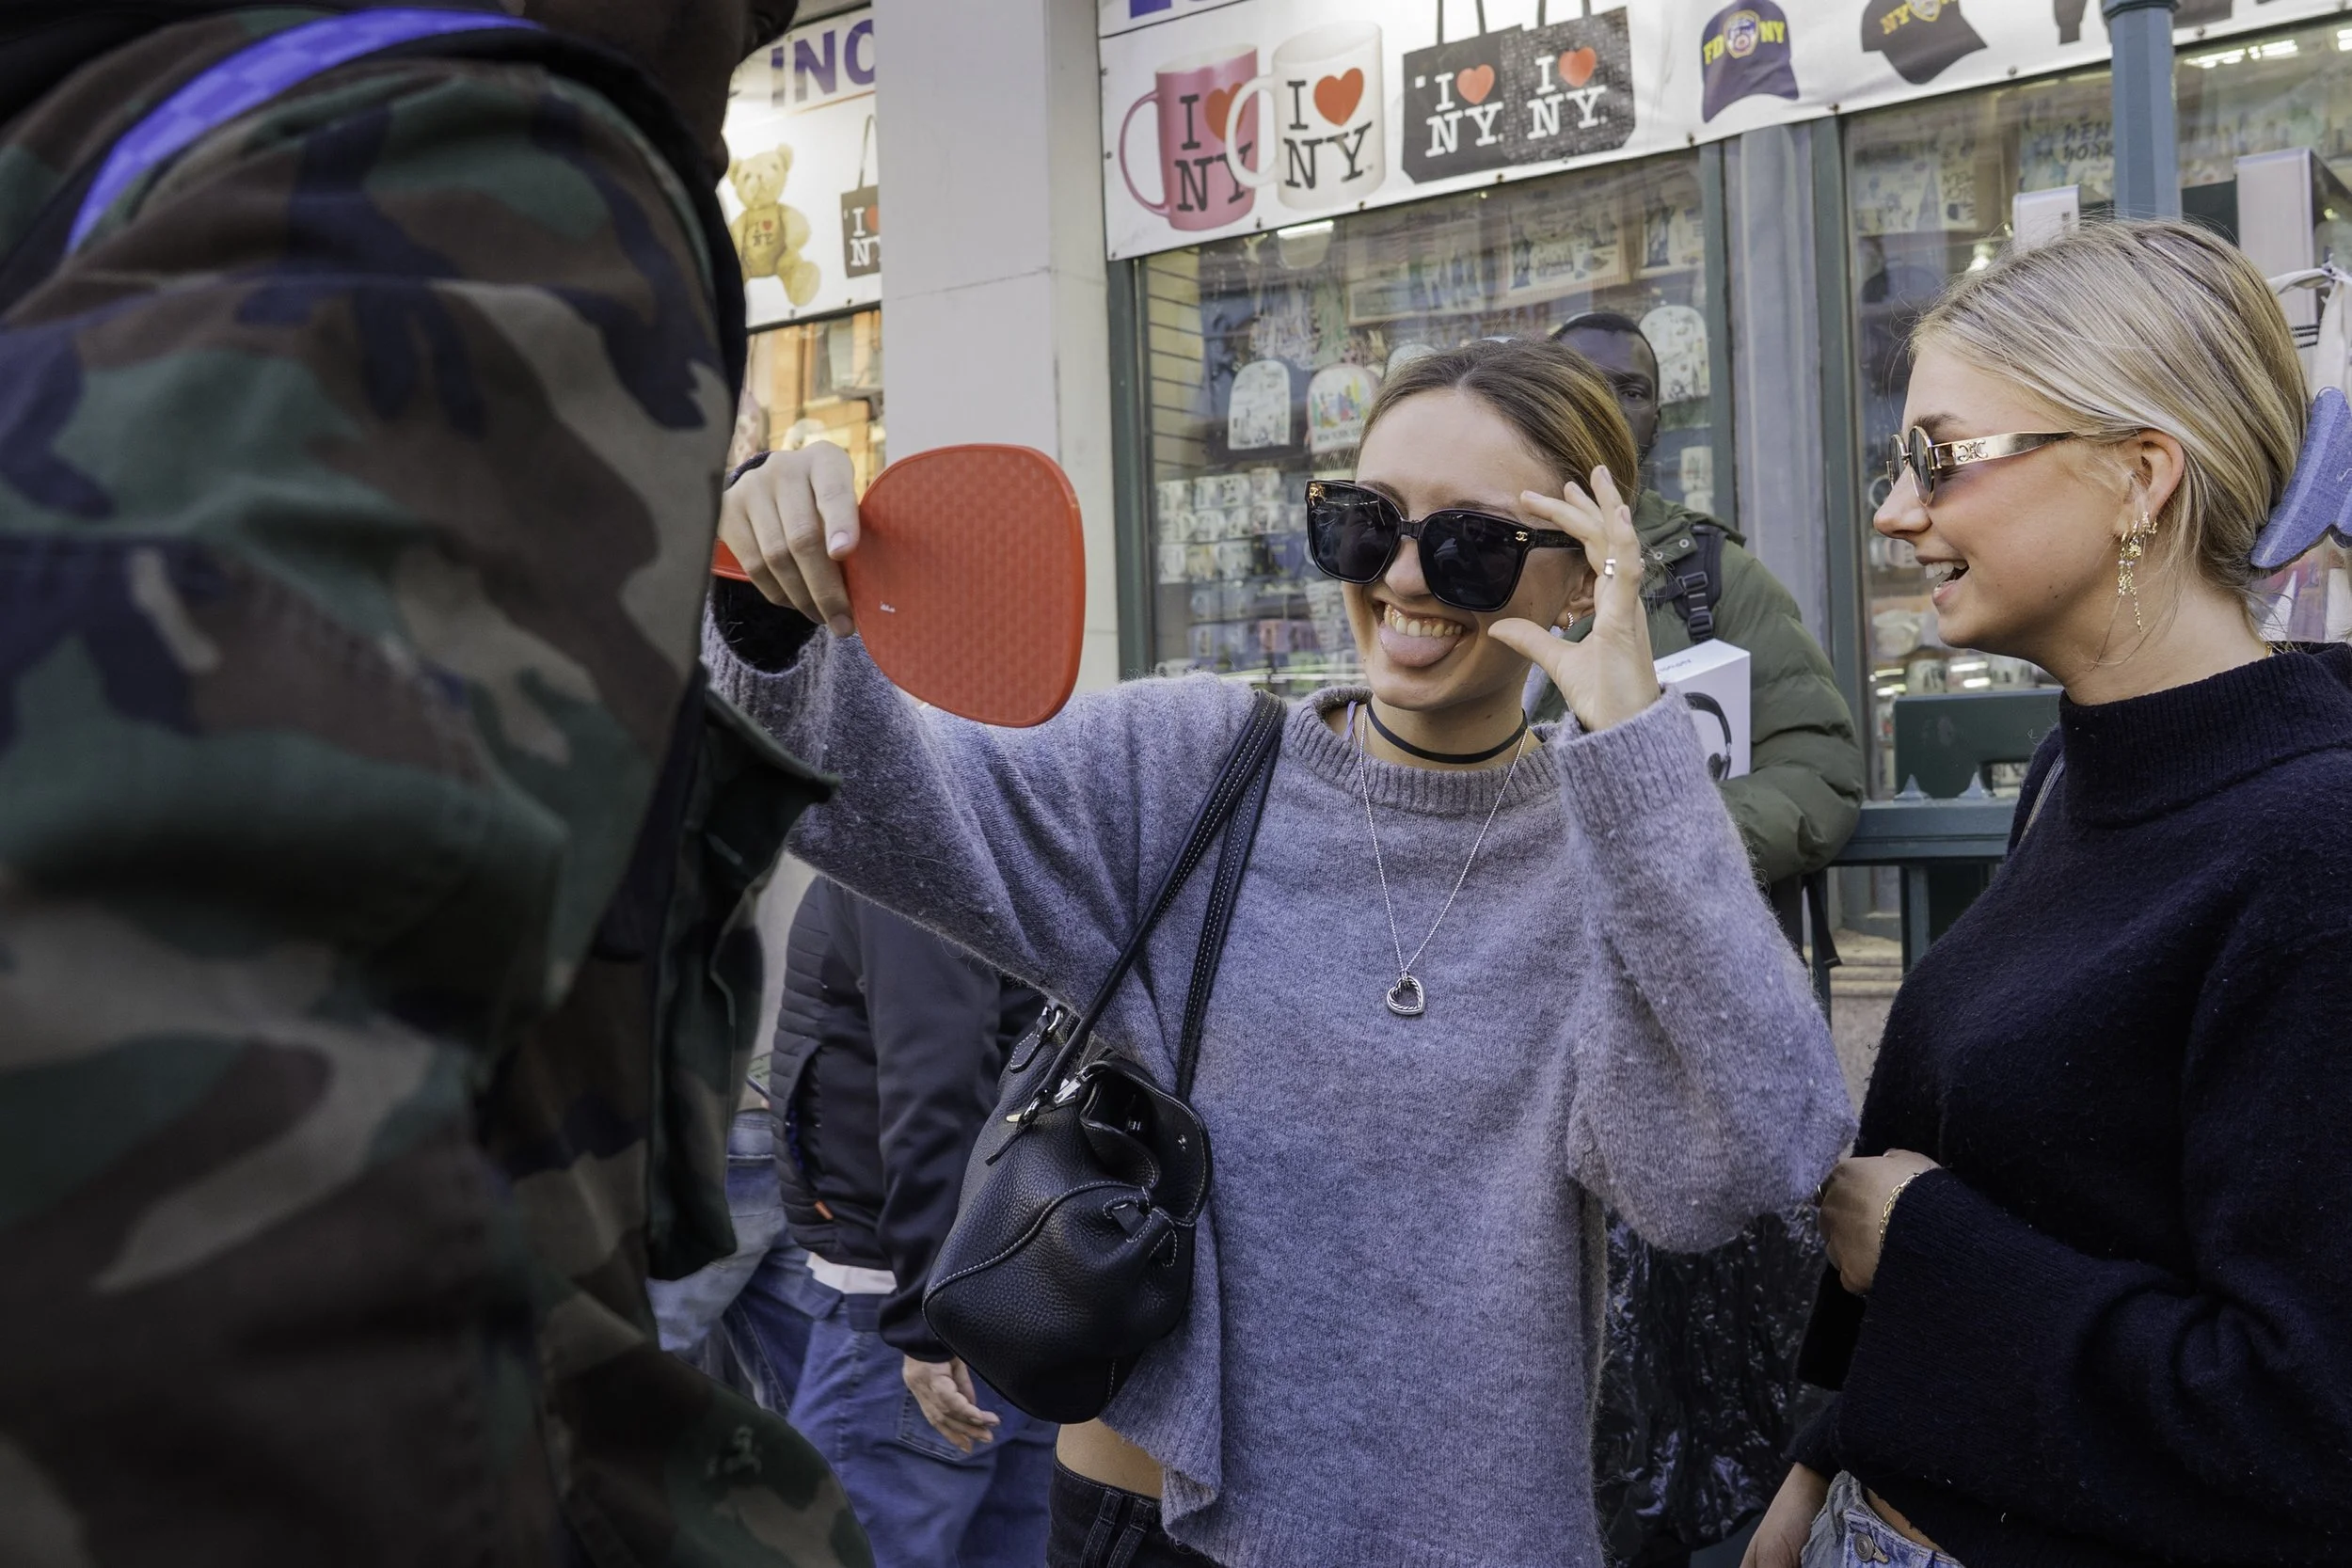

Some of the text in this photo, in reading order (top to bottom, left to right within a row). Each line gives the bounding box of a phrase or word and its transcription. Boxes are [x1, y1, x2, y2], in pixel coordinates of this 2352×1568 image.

[1435, 72, 1455, 112] I
[1534, 55, 1556, 95] I
[1180, 93, 1201, 150] I
[1287, 80, 1309, 131] I
[1283, 120, 1373, 190] NY
[849, 234, 882, 266] N
